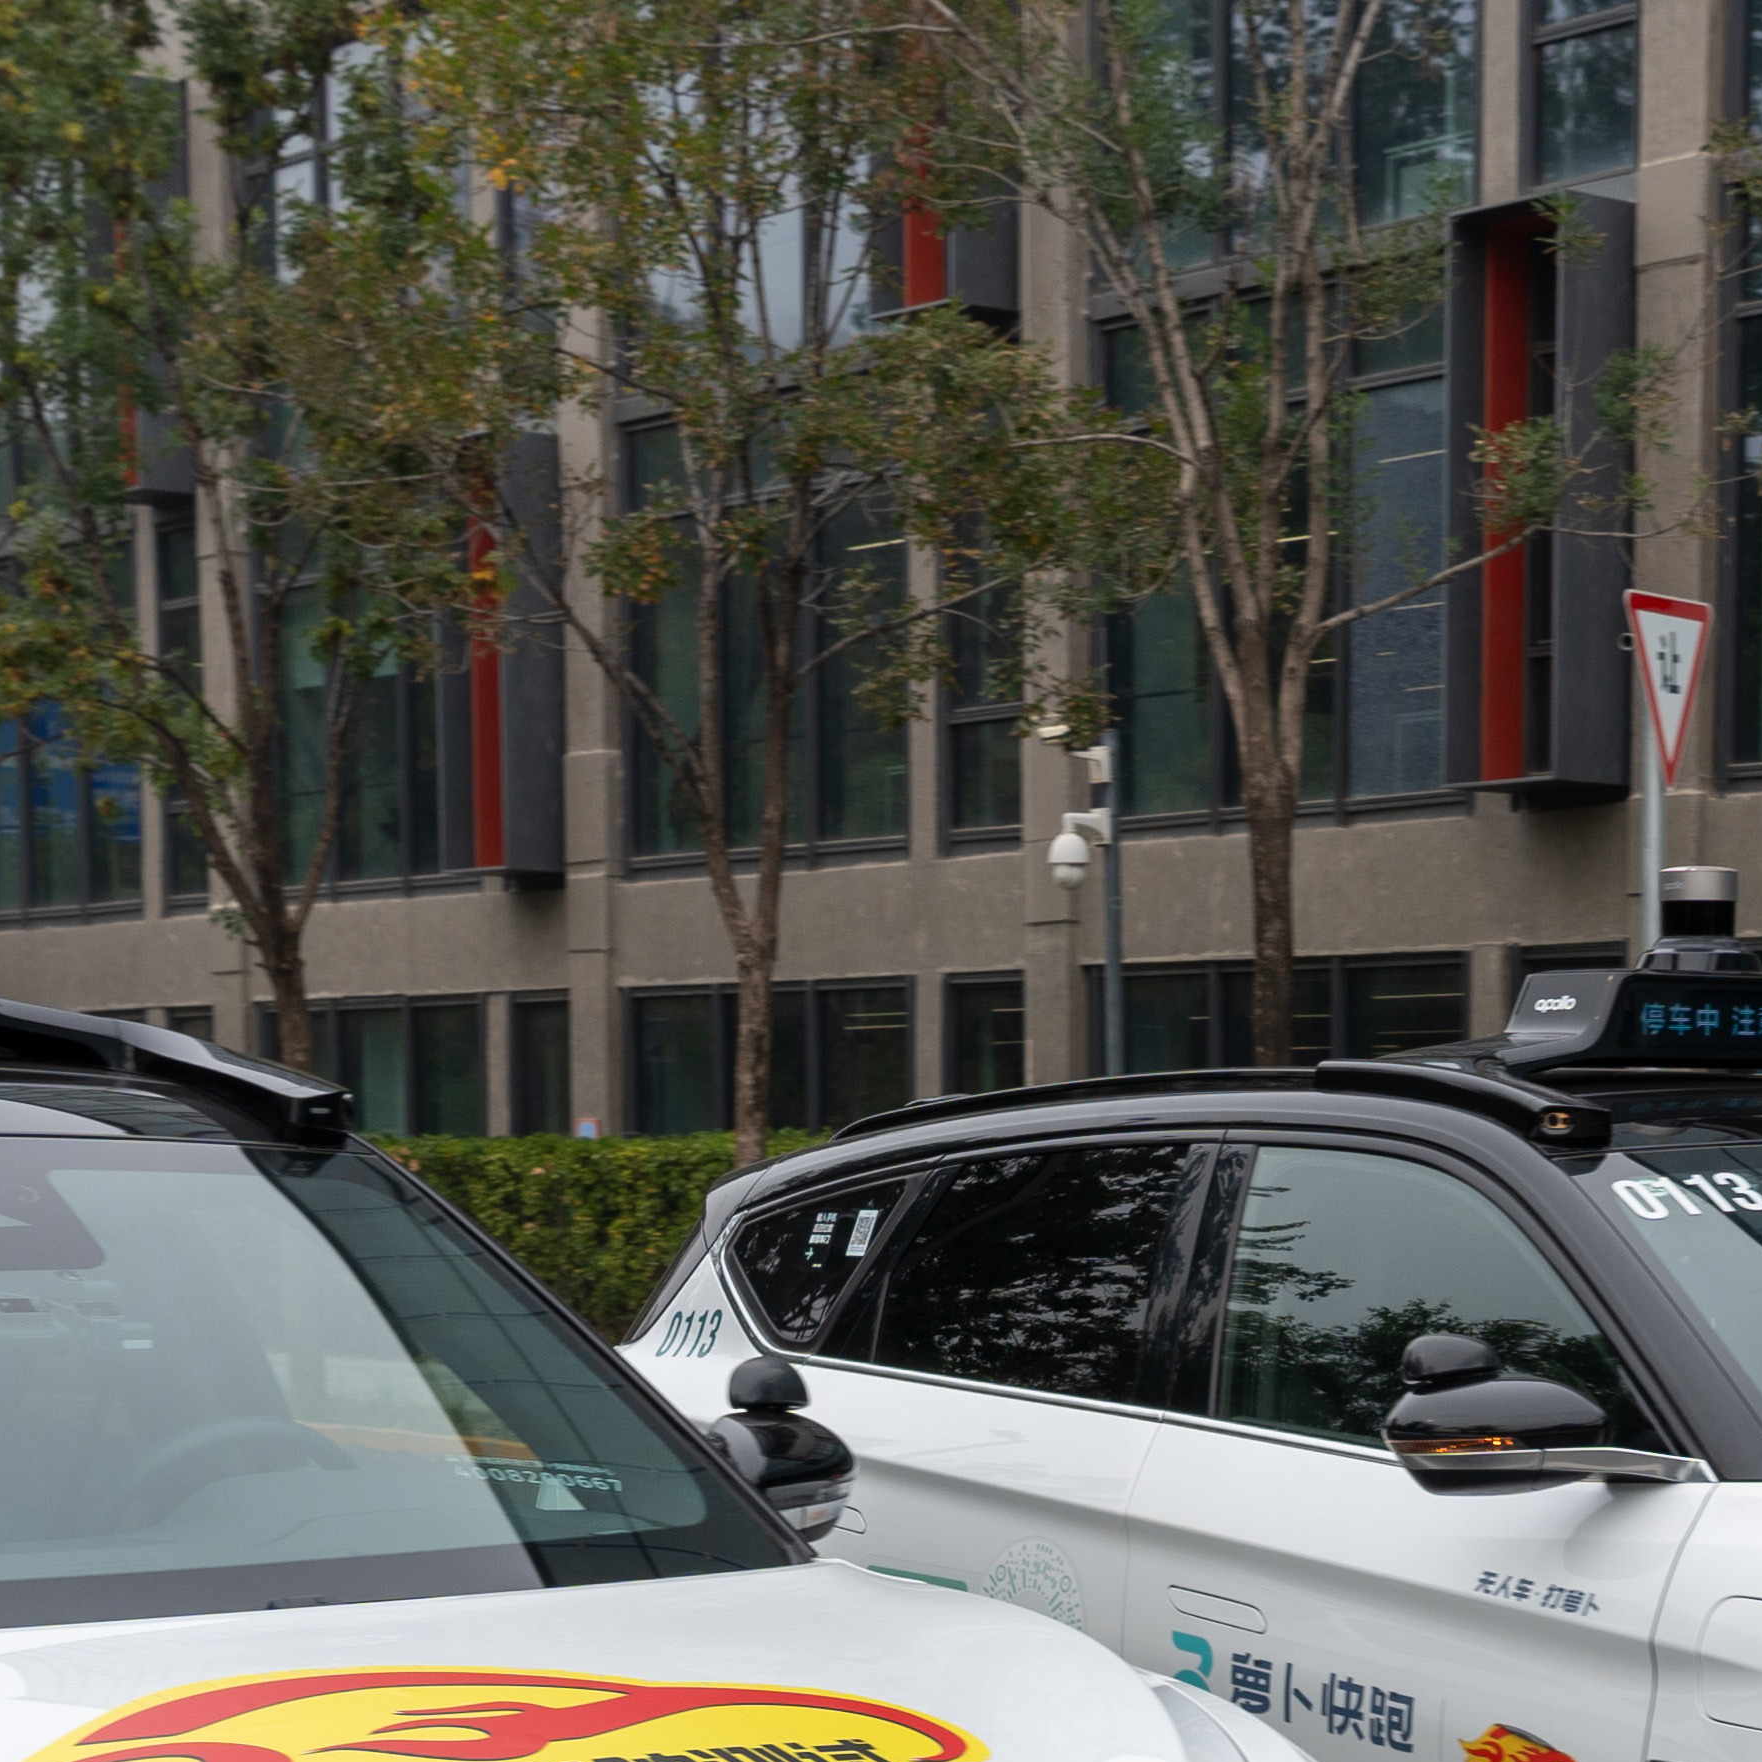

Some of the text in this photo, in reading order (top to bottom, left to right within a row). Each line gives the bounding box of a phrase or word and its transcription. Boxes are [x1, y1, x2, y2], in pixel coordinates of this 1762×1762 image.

[1534, 995, 1576, 1014] apollo
[1640, 1003, 1720, 1036] 停车中
[655, 1308, 723, 1358] 0113
[1230, 1652, 1416, 1754] 萝卜快跑
